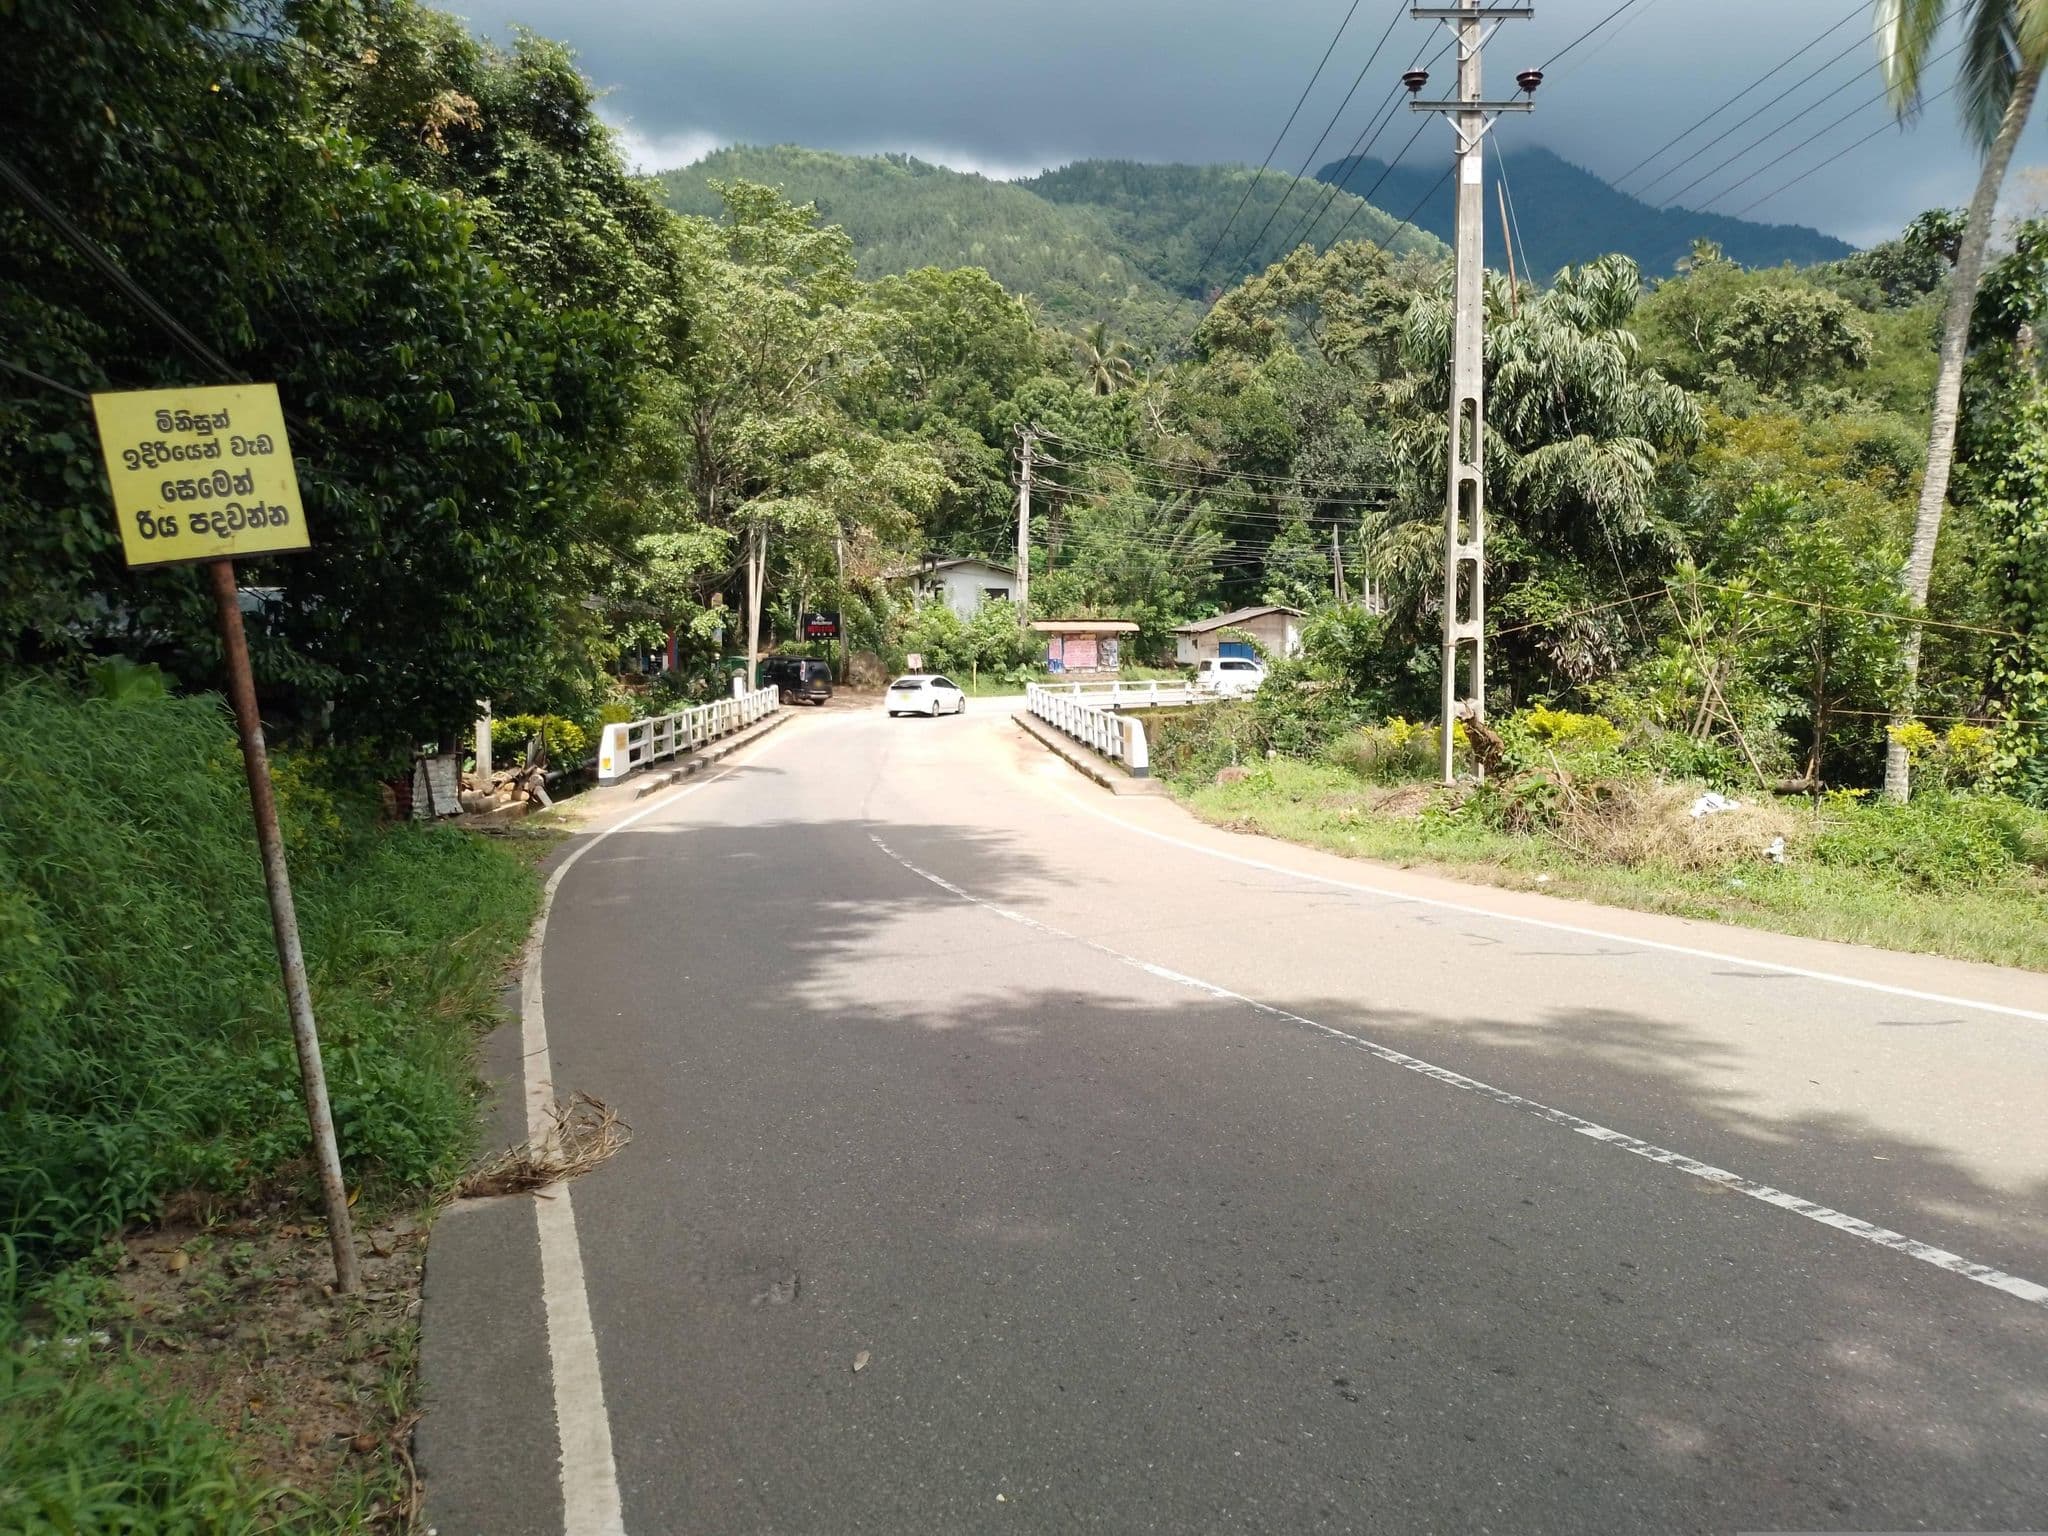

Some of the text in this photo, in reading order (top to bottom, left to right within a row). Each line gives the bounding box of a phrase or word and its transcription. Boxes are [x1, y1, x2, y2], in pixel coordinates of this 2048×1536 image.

[155, 408, 230, 436] මිනිසුන්
[230, 433, 274, 457] වැඩ
[161, 468, 255, 503] සෙමෙන්
[136, 500, 290, 540] රිය පදවන්න
